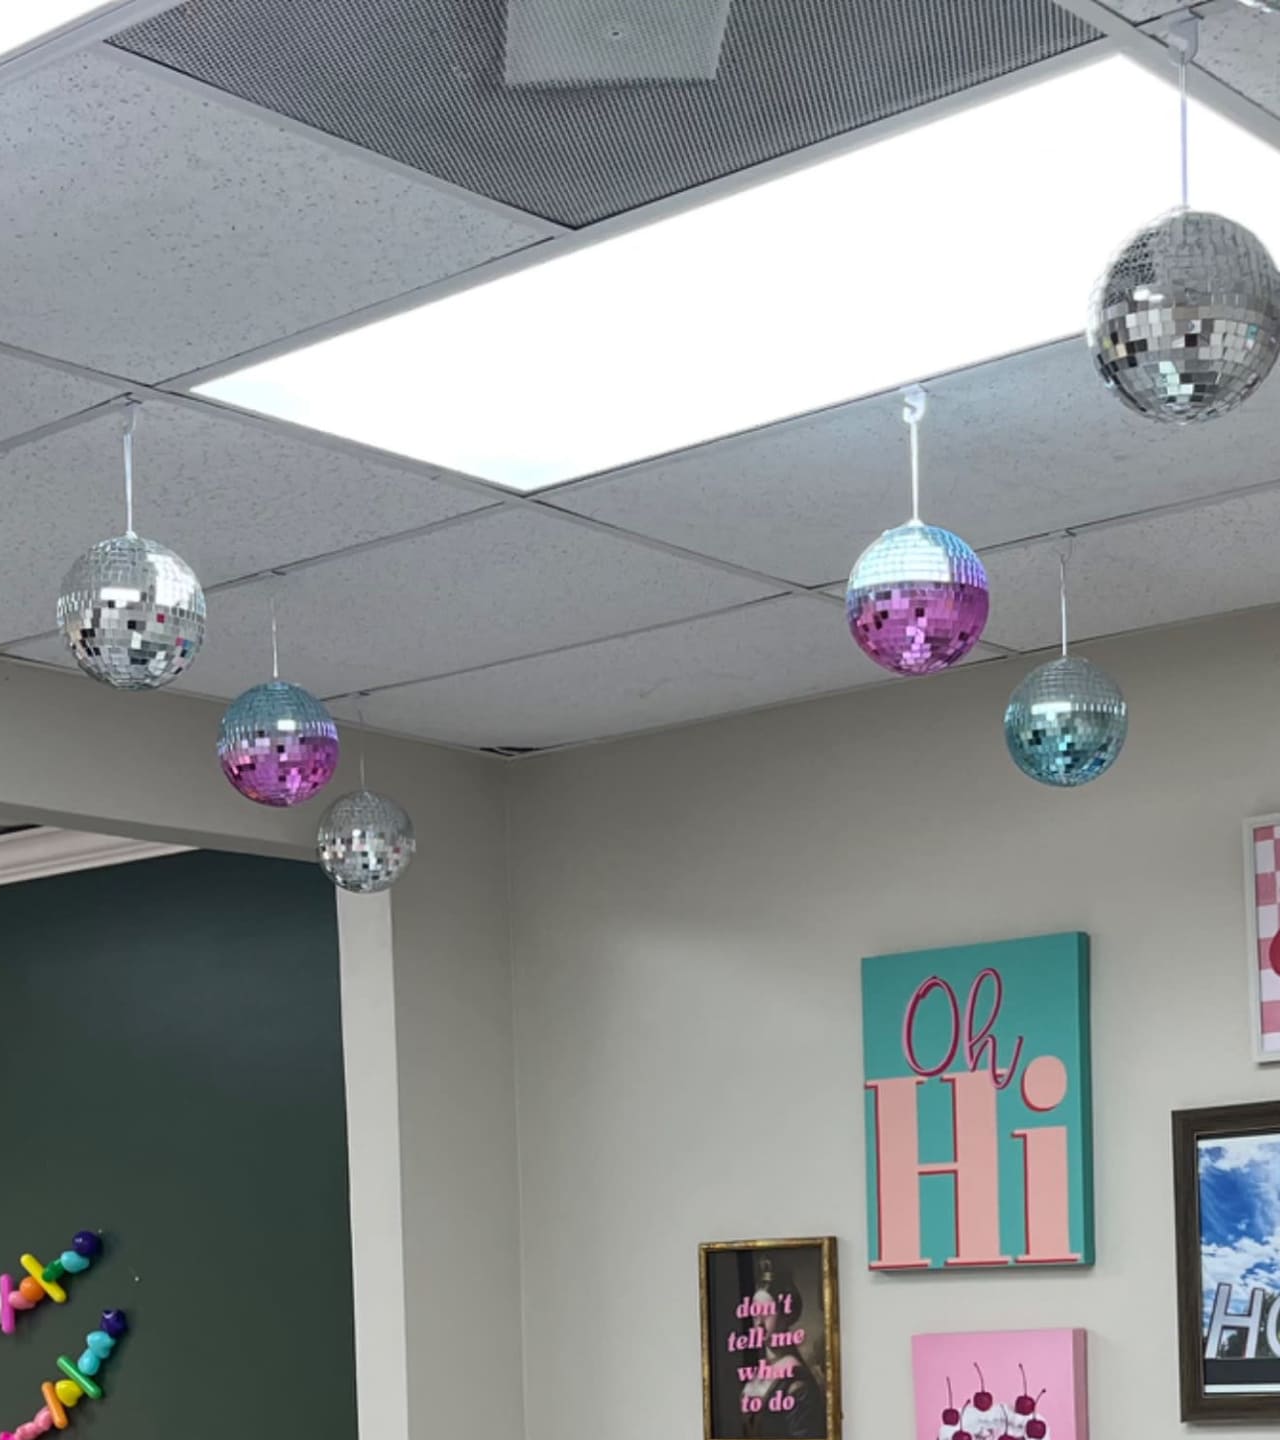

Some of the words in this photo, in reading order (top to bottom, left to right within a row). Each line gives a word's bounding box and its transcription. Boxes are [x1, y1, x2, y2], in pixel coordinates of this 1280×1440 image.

[902, 968, 1023, 1090] Oh
[864, 1055, 1082, 1269] Hi
[736, 1293, 792, 1318] don't
[728, 1327, 764, 1352] tell
[770, 1328, 804, 1347] me
[737, 1359, 794, 1381] what
[741, 1393, 762, 1413] to
[769, 1390, 795, 1412] do
